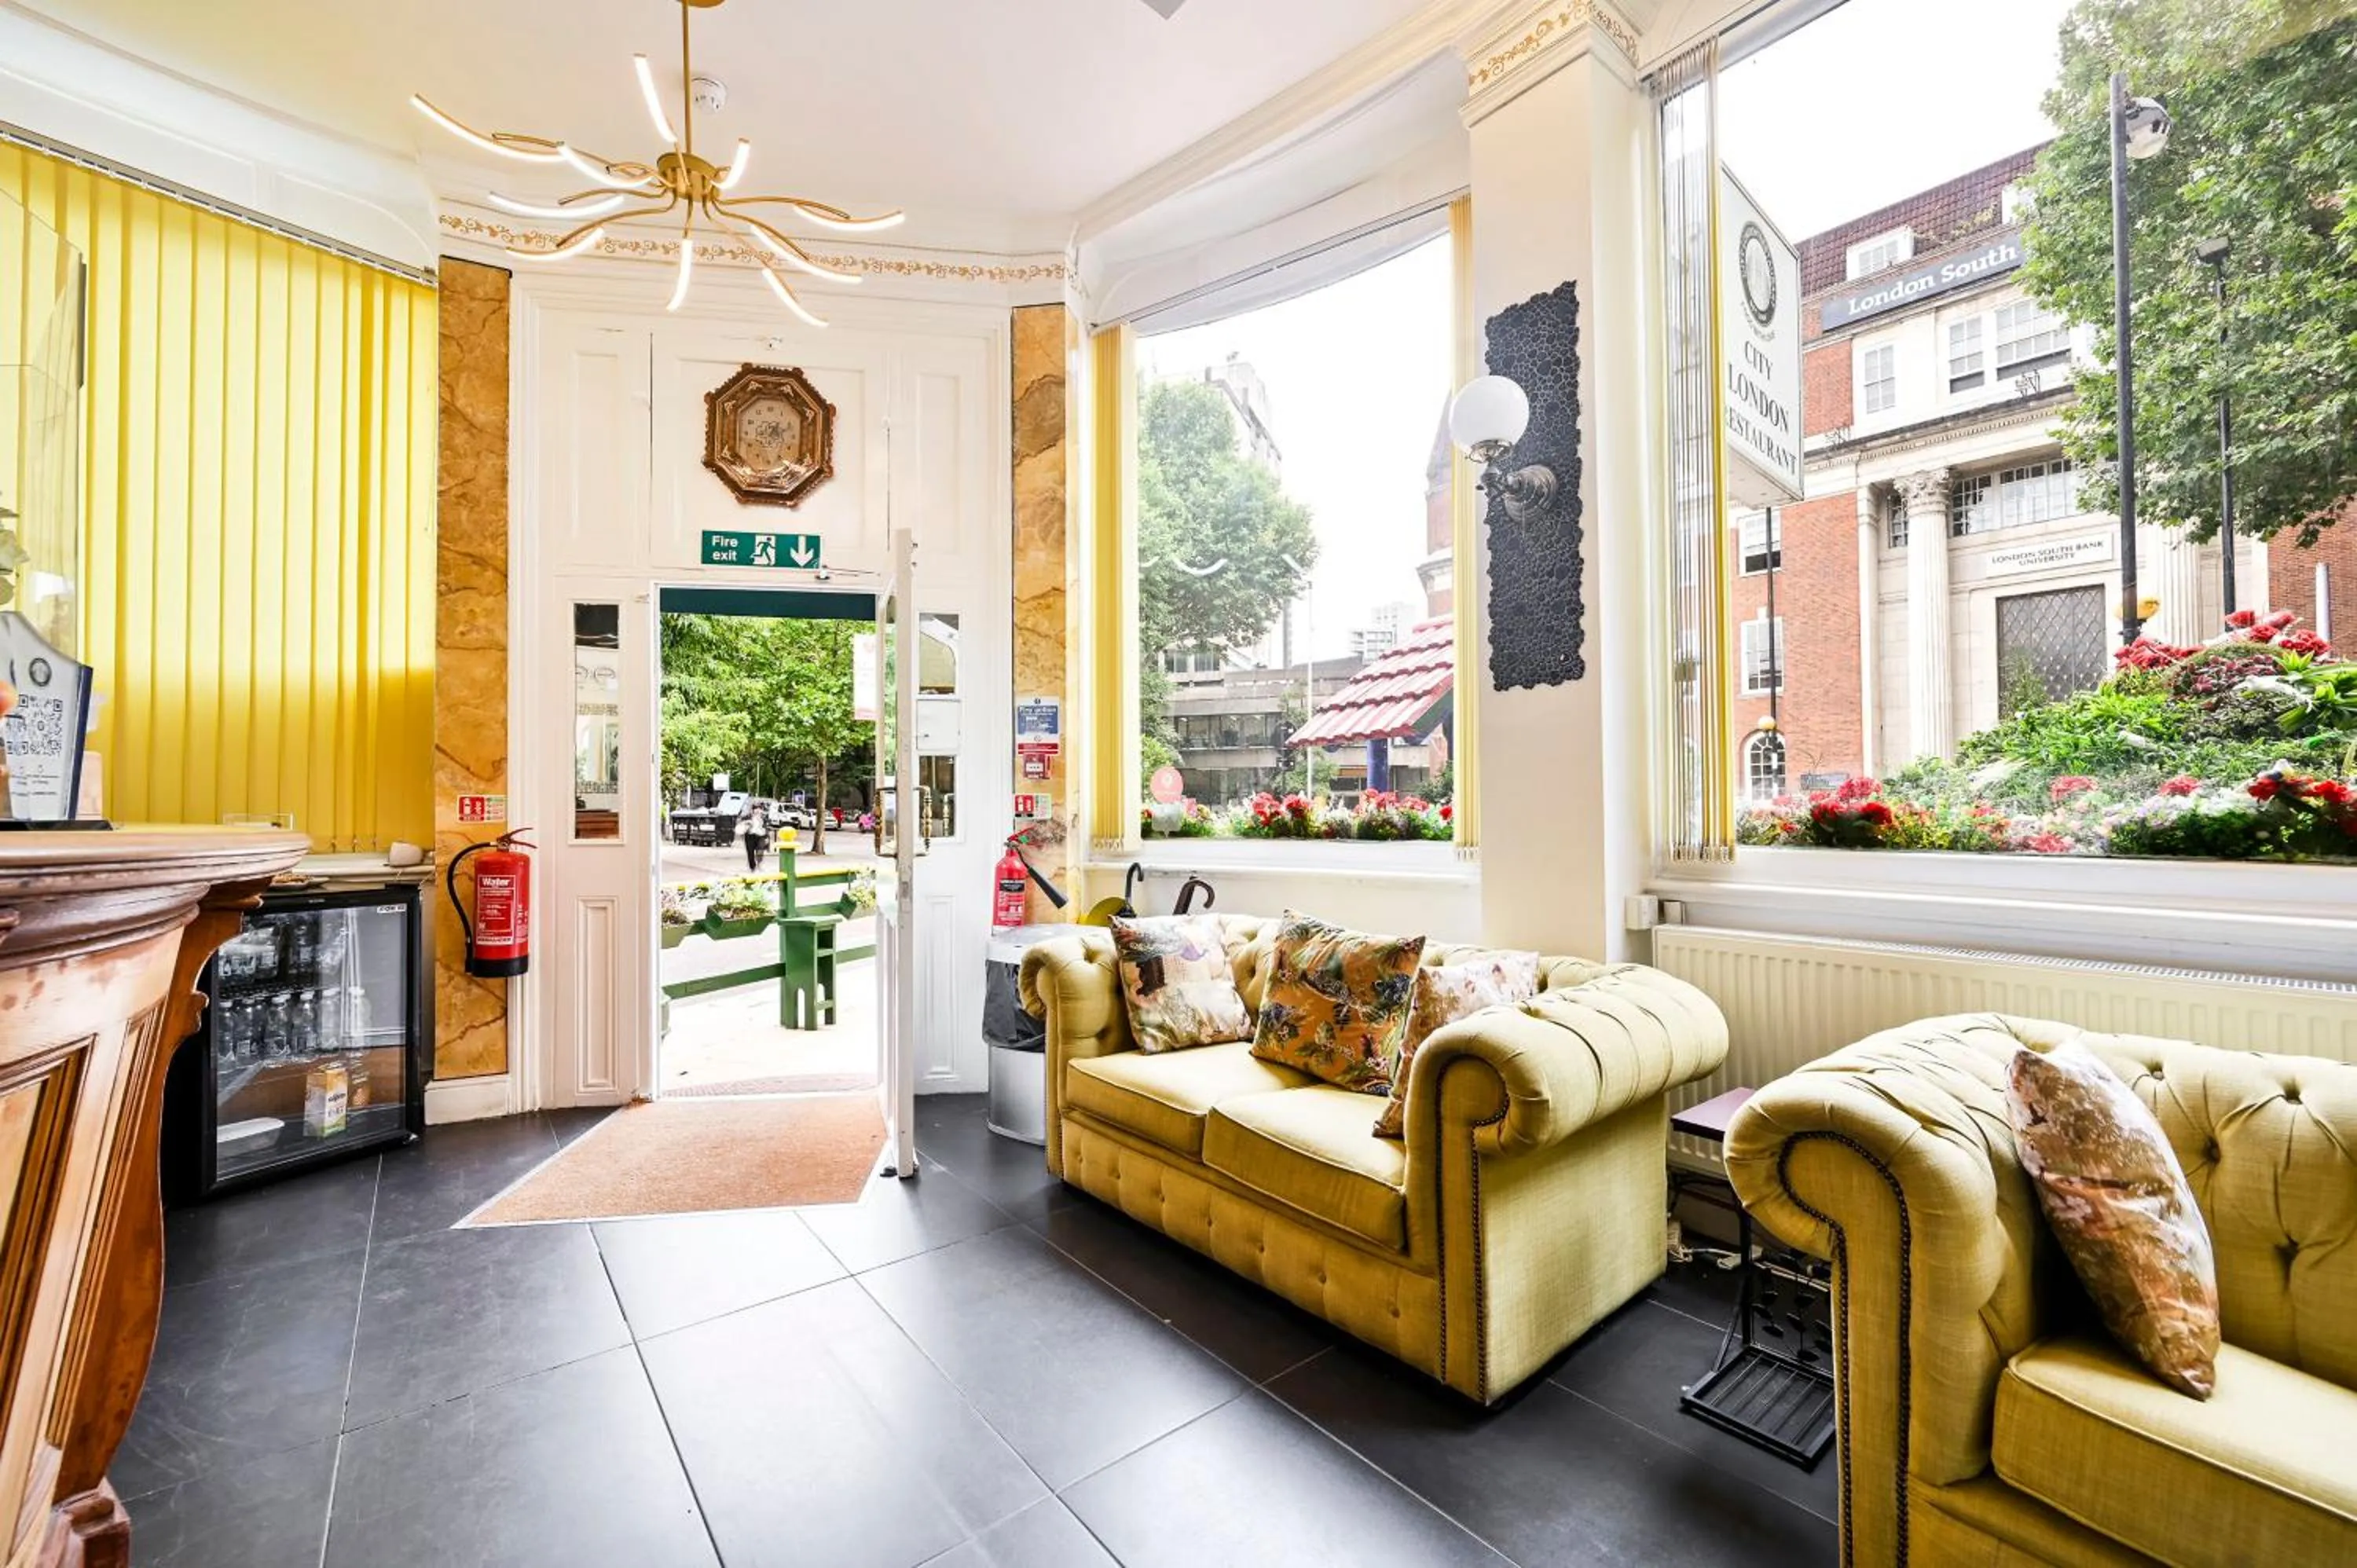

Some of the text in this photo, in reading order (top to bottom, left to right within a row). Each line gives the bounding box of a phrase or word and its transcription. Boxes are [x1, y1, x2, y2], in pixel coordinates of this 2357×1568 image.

[1849, 244, 2018, 315] London South
[1745, 340, 1773, 380] CITY
[1728, 361, 1789, 434] LONDON
[712, 535, 738, 548] Fire
[1992, 540, 2103, 564] LONDON SOUTH BANK
[713, 549, 737, 562] exit
[2018, 552, 2075, 566] UNIVERSITY
